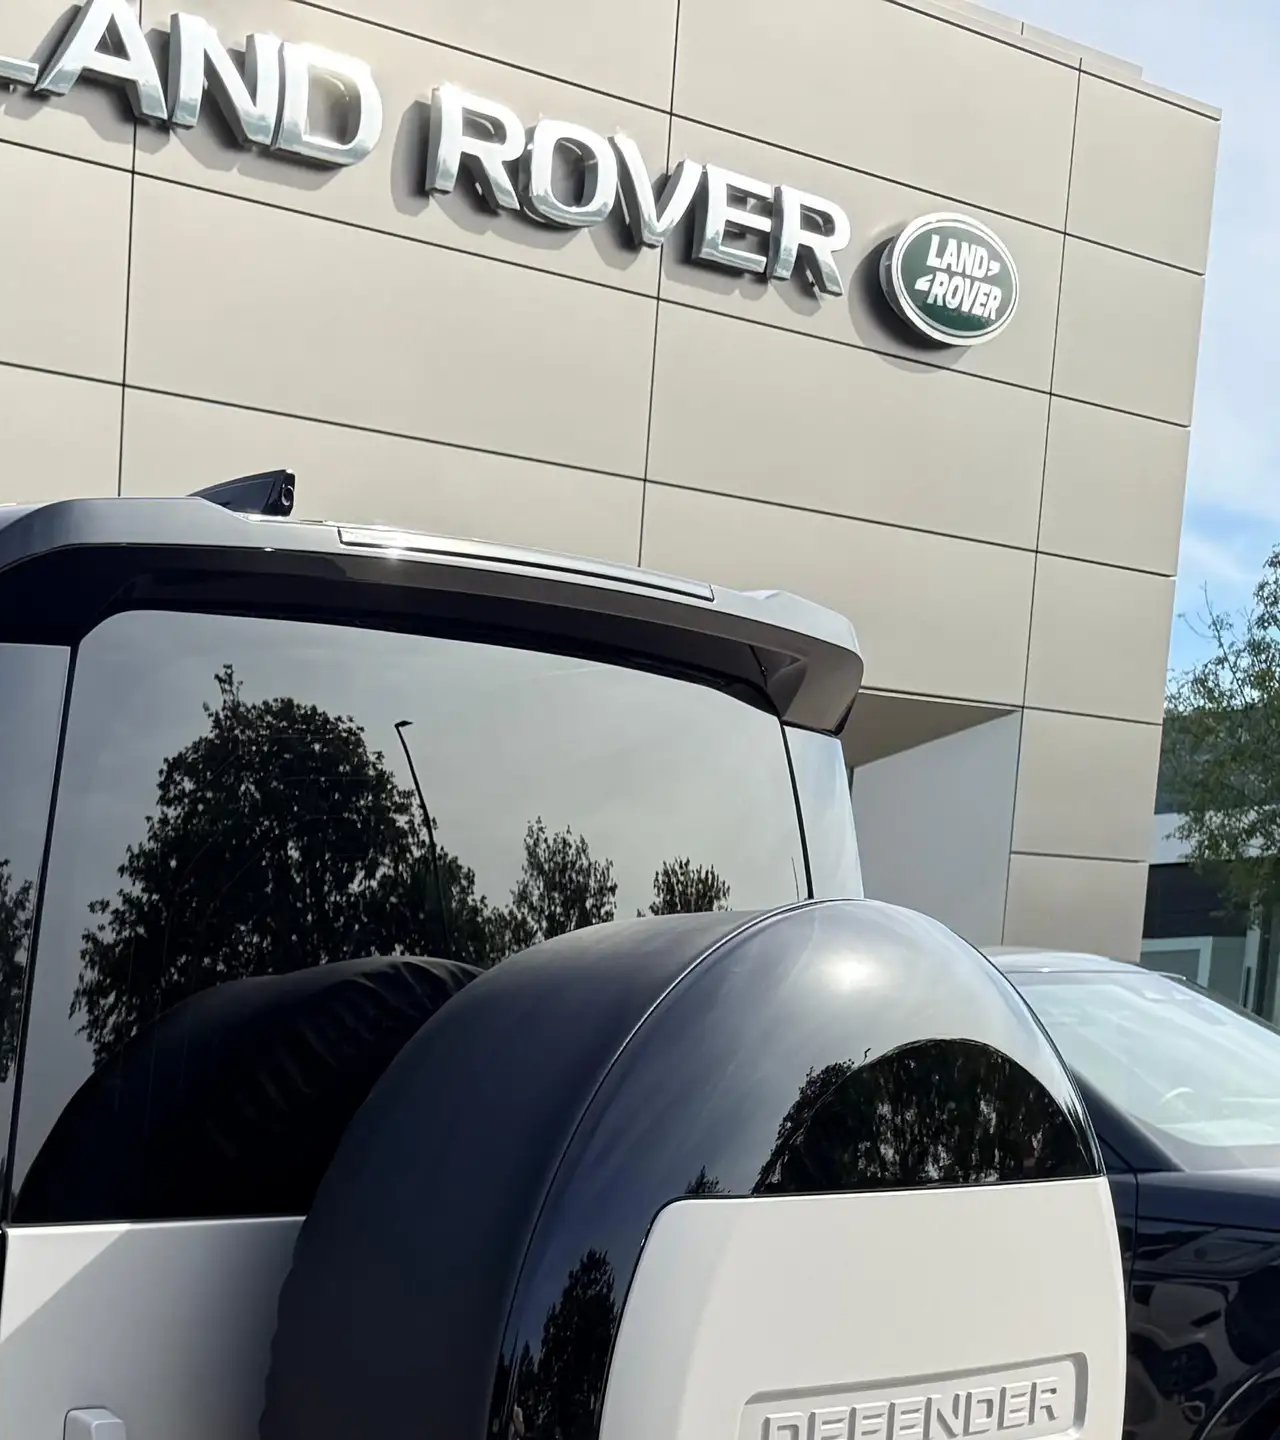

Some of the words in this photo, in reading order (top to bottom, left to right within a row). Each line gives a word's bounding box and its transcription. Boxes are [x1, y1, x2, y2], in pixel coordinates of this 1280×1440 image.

[426, 80, 852, 298] ROVER
[926, 234, 989, 279] LAND
[927, 271, 1002, 320] ROVER
